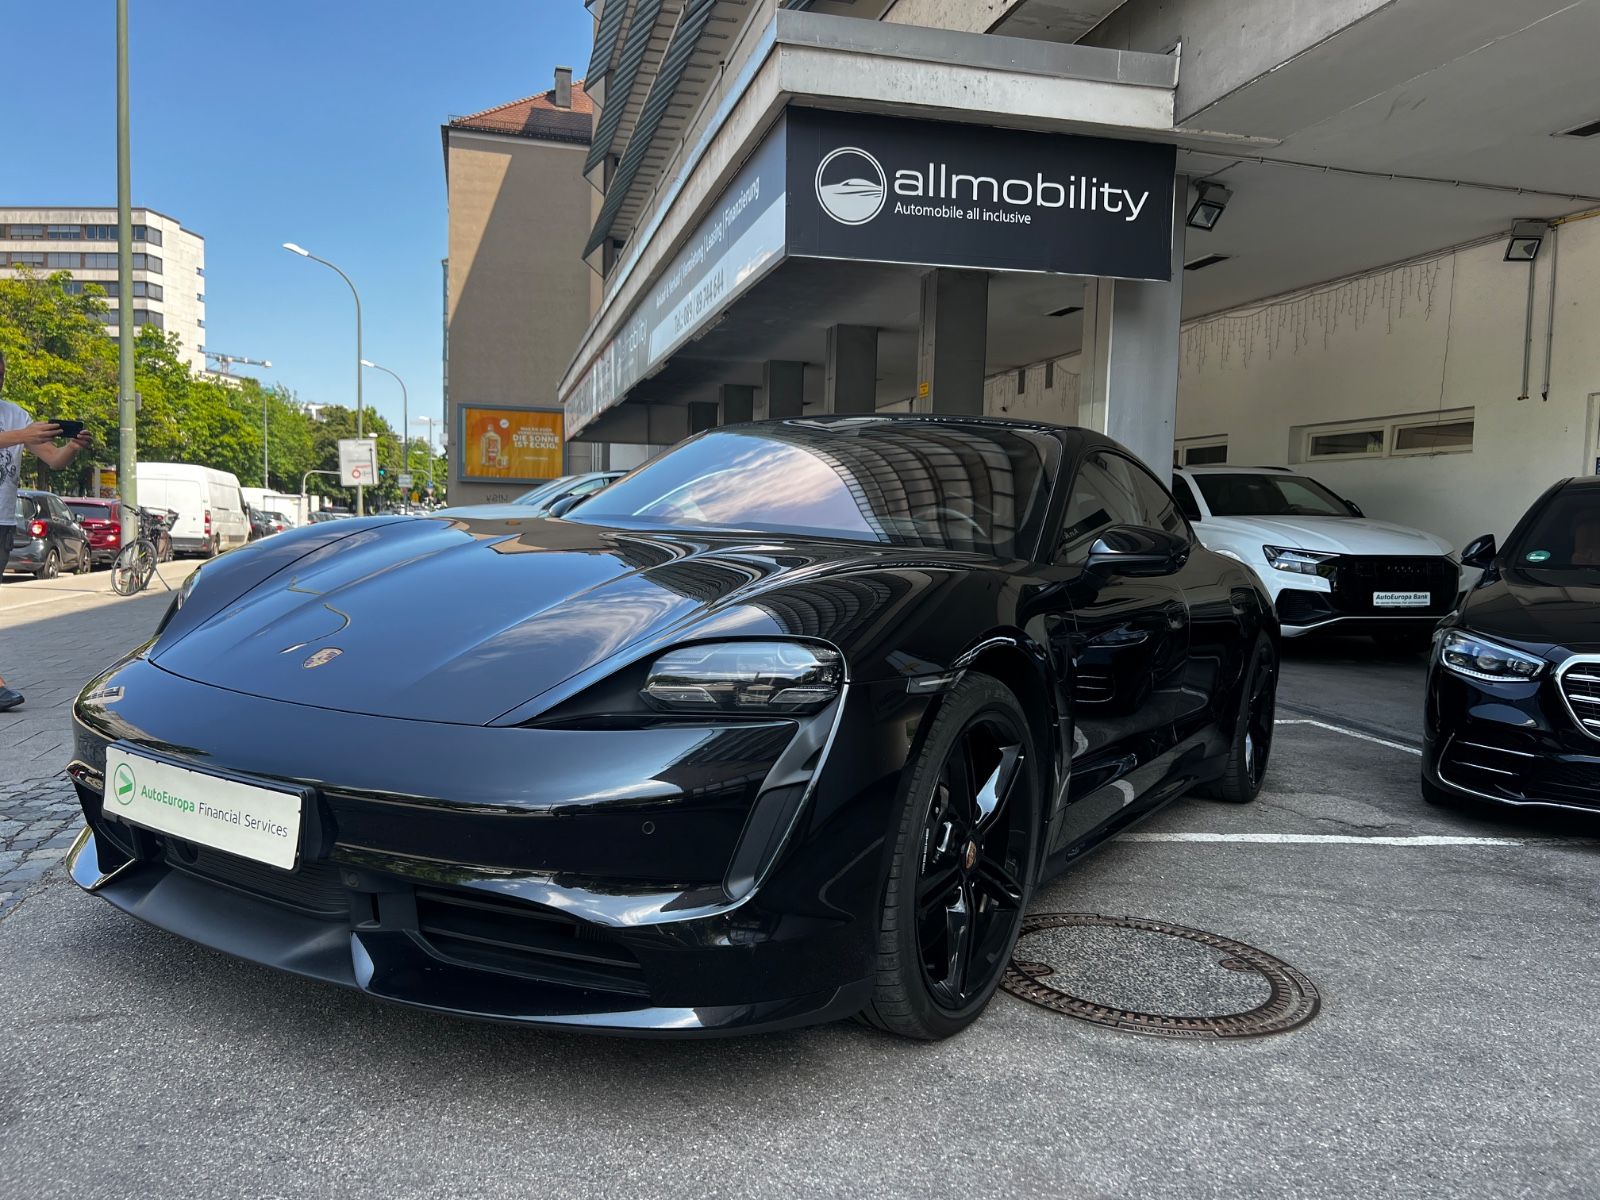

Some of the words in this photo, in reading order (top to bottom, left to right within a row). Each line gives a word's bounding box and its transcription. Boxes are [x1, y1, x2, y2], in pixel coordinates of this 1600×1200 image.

[894, 163, 1149, 222] allmobility
[706, 222, 722, 252] Leasing
[725, 176, 760, 229] Finanzierung
[894, 202, 964, 220] Automobile
[966, 207, 980, 220] all
[983, 210, 1031, 225] inclusive
[529, 435, 560, 444] SONNE
[1376, 593, 1412, 601] AutoEuropa
[141, 785, 195, 812] AutoEuropa
[199, 802, 241, 825] Financial
[244, 814, 288, 838] Services
